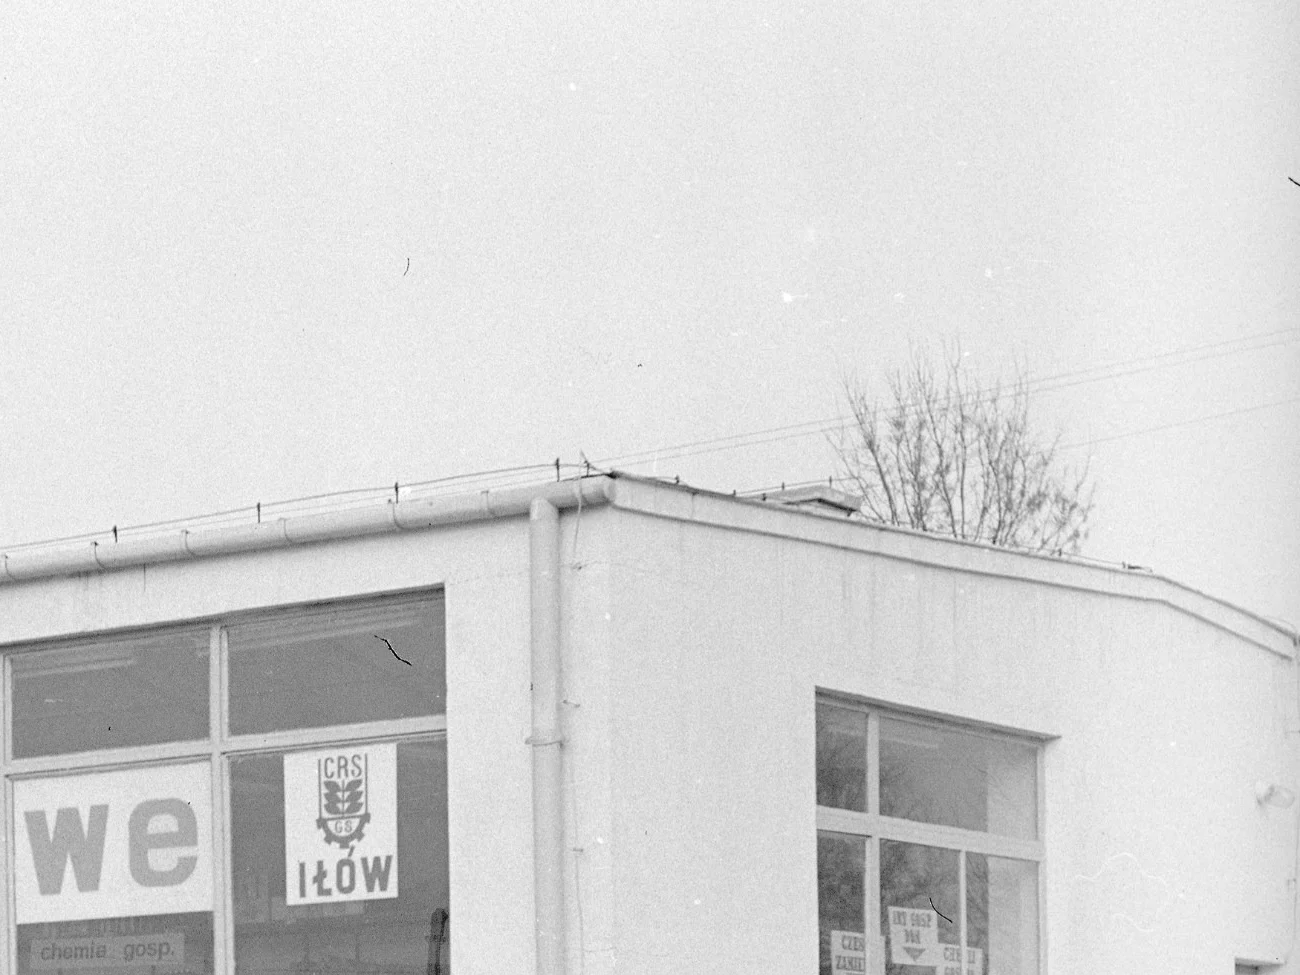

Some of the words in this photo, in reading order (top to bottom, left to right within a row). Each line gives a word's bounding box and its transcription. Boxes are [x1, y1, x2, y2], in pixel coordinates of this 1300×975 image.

[323, 753, 363, 779] CRS
[334, 819, 354, 834] GS
[299, 845, 393, 899] IŁÓW
[41, 941, 107, 961] chemia
[123, 940, 175, 962] gosp.
